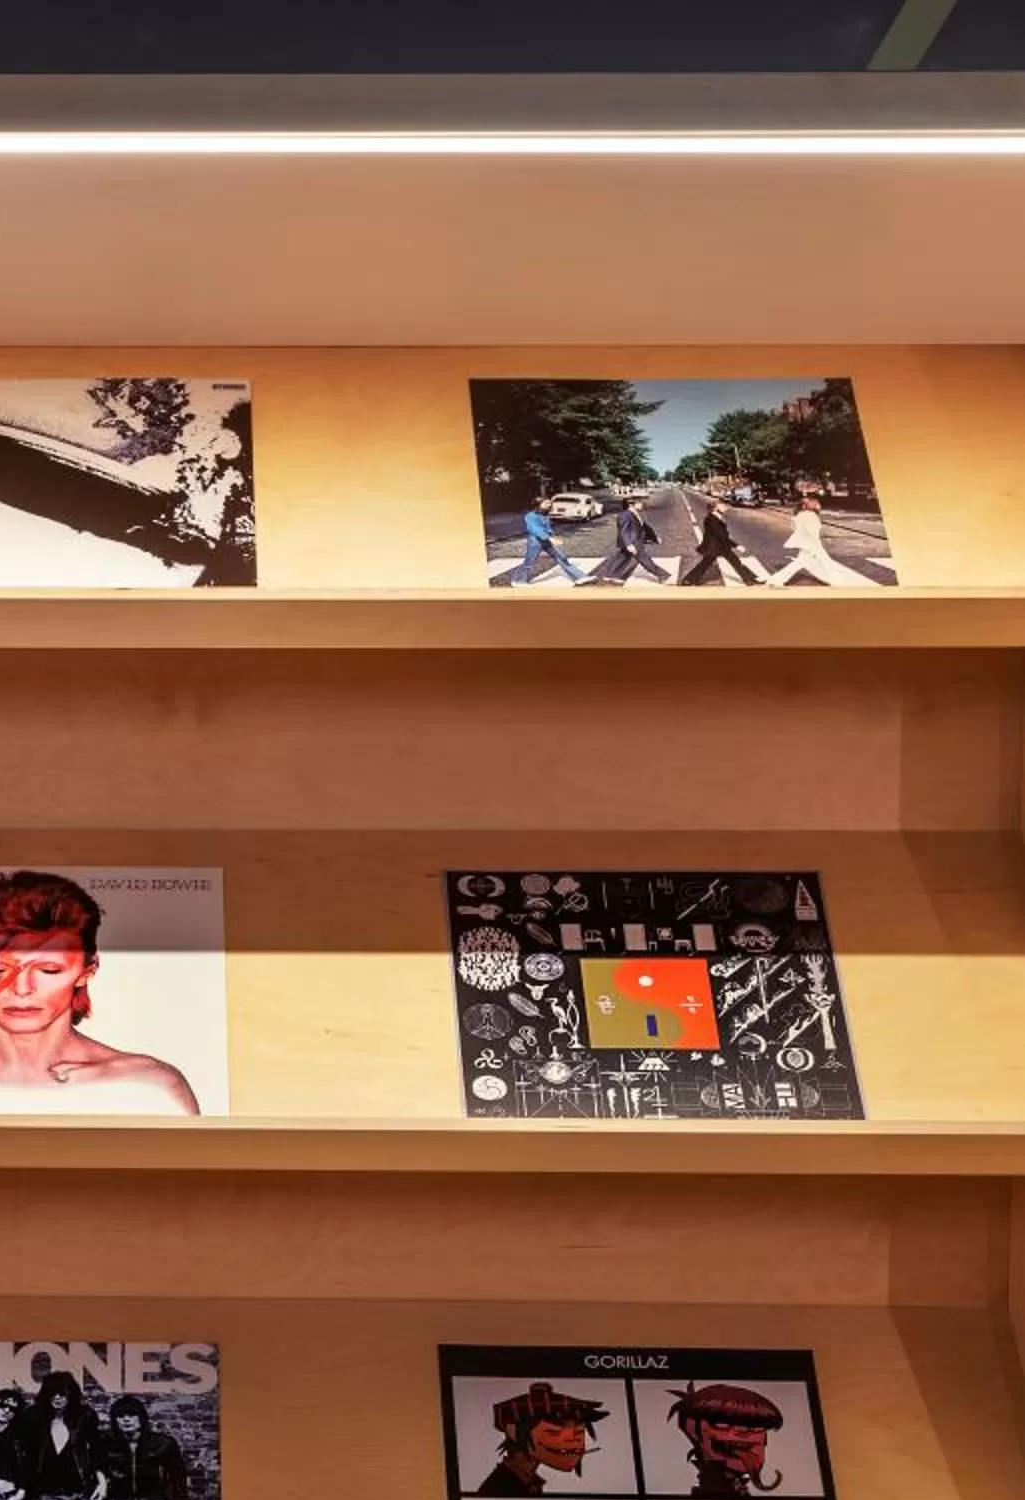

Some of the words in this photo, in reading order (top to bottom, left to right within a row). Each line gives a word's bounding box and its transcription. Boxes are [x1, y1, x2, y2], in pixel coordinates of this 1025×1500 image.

[90, 879, 148, 891] DAVID
[152, 879, 211, 891] BOWIE
[584, 1355, 670, 1369] GORILLAZ
